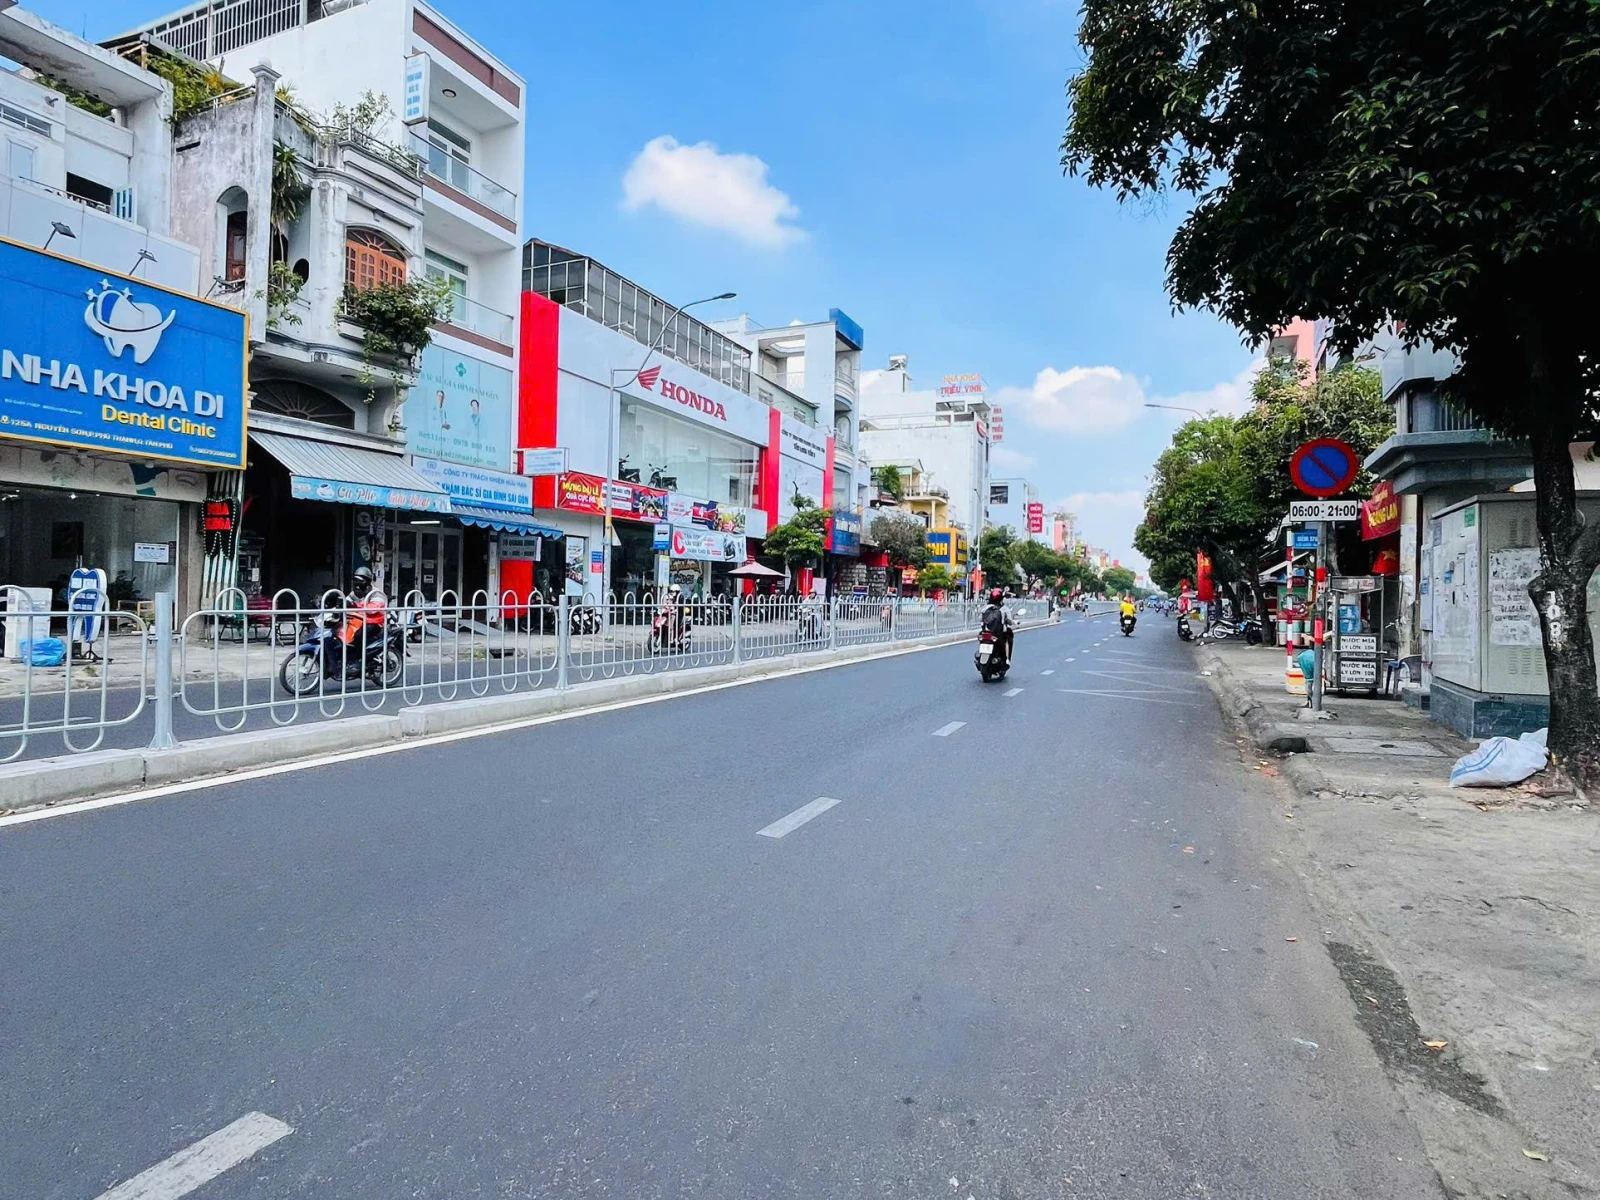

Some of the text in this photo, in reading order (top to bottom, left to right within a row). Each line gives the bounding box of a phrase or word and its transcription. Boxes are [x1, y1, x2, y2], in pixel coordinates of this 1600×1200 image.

[2, 350, 223, 418] NHA KHOA DI
[660, 378, 727, 422] HONDA
[102, 404, 164, 430] Dental
[168, 416, 216, 438] Clinic
[483, 488, 492, 500] GIA
[1292, 506, 1319, 517] 06:00
[1327, 505, 1356, 517] 21:00
